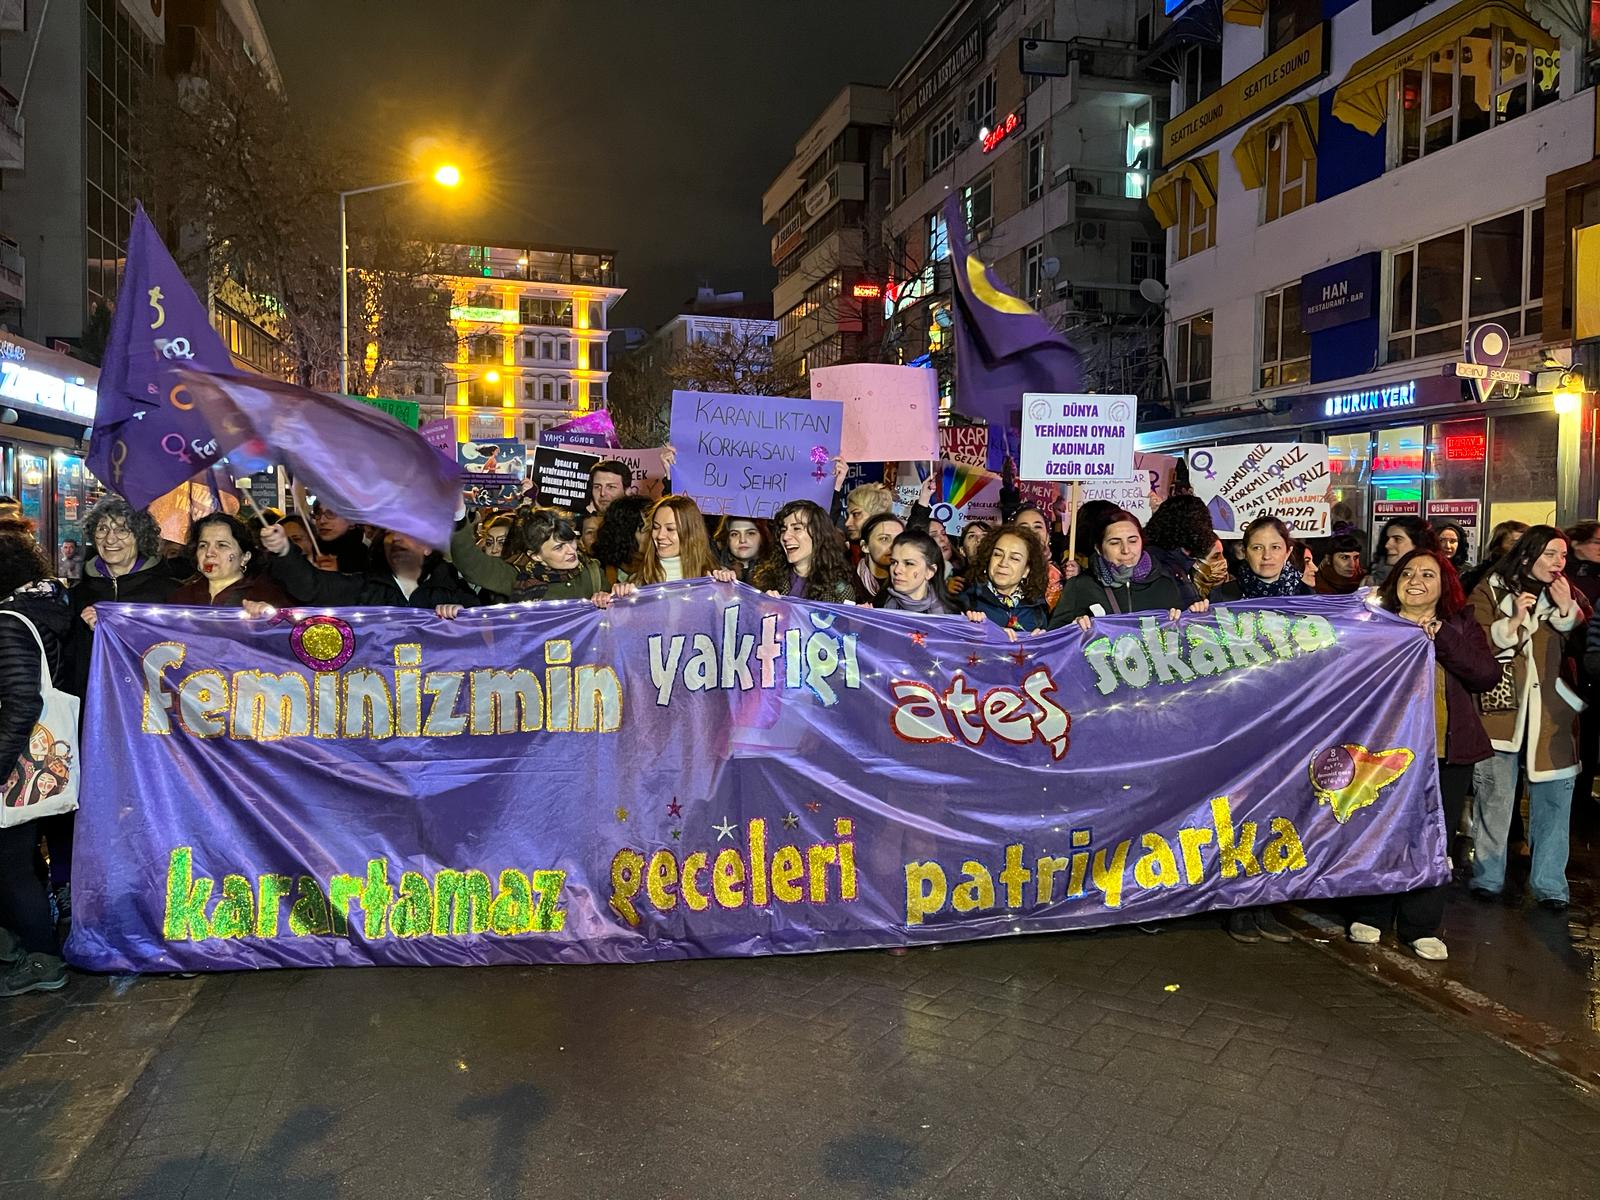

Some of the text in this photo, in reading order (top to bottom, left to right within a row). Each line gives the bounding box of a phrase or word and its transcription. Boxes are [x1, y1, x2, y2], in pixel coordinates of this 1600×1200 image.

[938, 30, 979, 89] RESTAURANT
[1244, 49, 1310, 101] SEATTLE SOUND
[1170, 103, 1224, 147] SEATTLE SOUND
[1307, 292, 1364, 315] RESTAURANT BAR
[1322, 280, 1348, 302] HAN
[1490, 370, 1520, 382] SPORTS
[1381, 380, 1416, 408] YERİ
[695, 397, 831, 434] KARANLIKTAN
[1063, 402, 1099, 418] DÜNYA
[1034, 422, 1126, 438] YERİNDEN OYNAR
[698, 430, 796, 463] KORKARSAN
[1052, 443, 1105, 455] KADINLAR
[739, 466, 789, 493] ŞEHRİ
[1045, 460, 1115, 475] ÖZGÜR OLSA!
[1082, 489, 1116, 500] YEMEK
[140, 604, 1338, 763] feminizmin yaktığı ateş sokakta
[1330, 749, 1336, 758] 8
[163, 795, 1308, 942] karartamaz geceleri patriyarka
